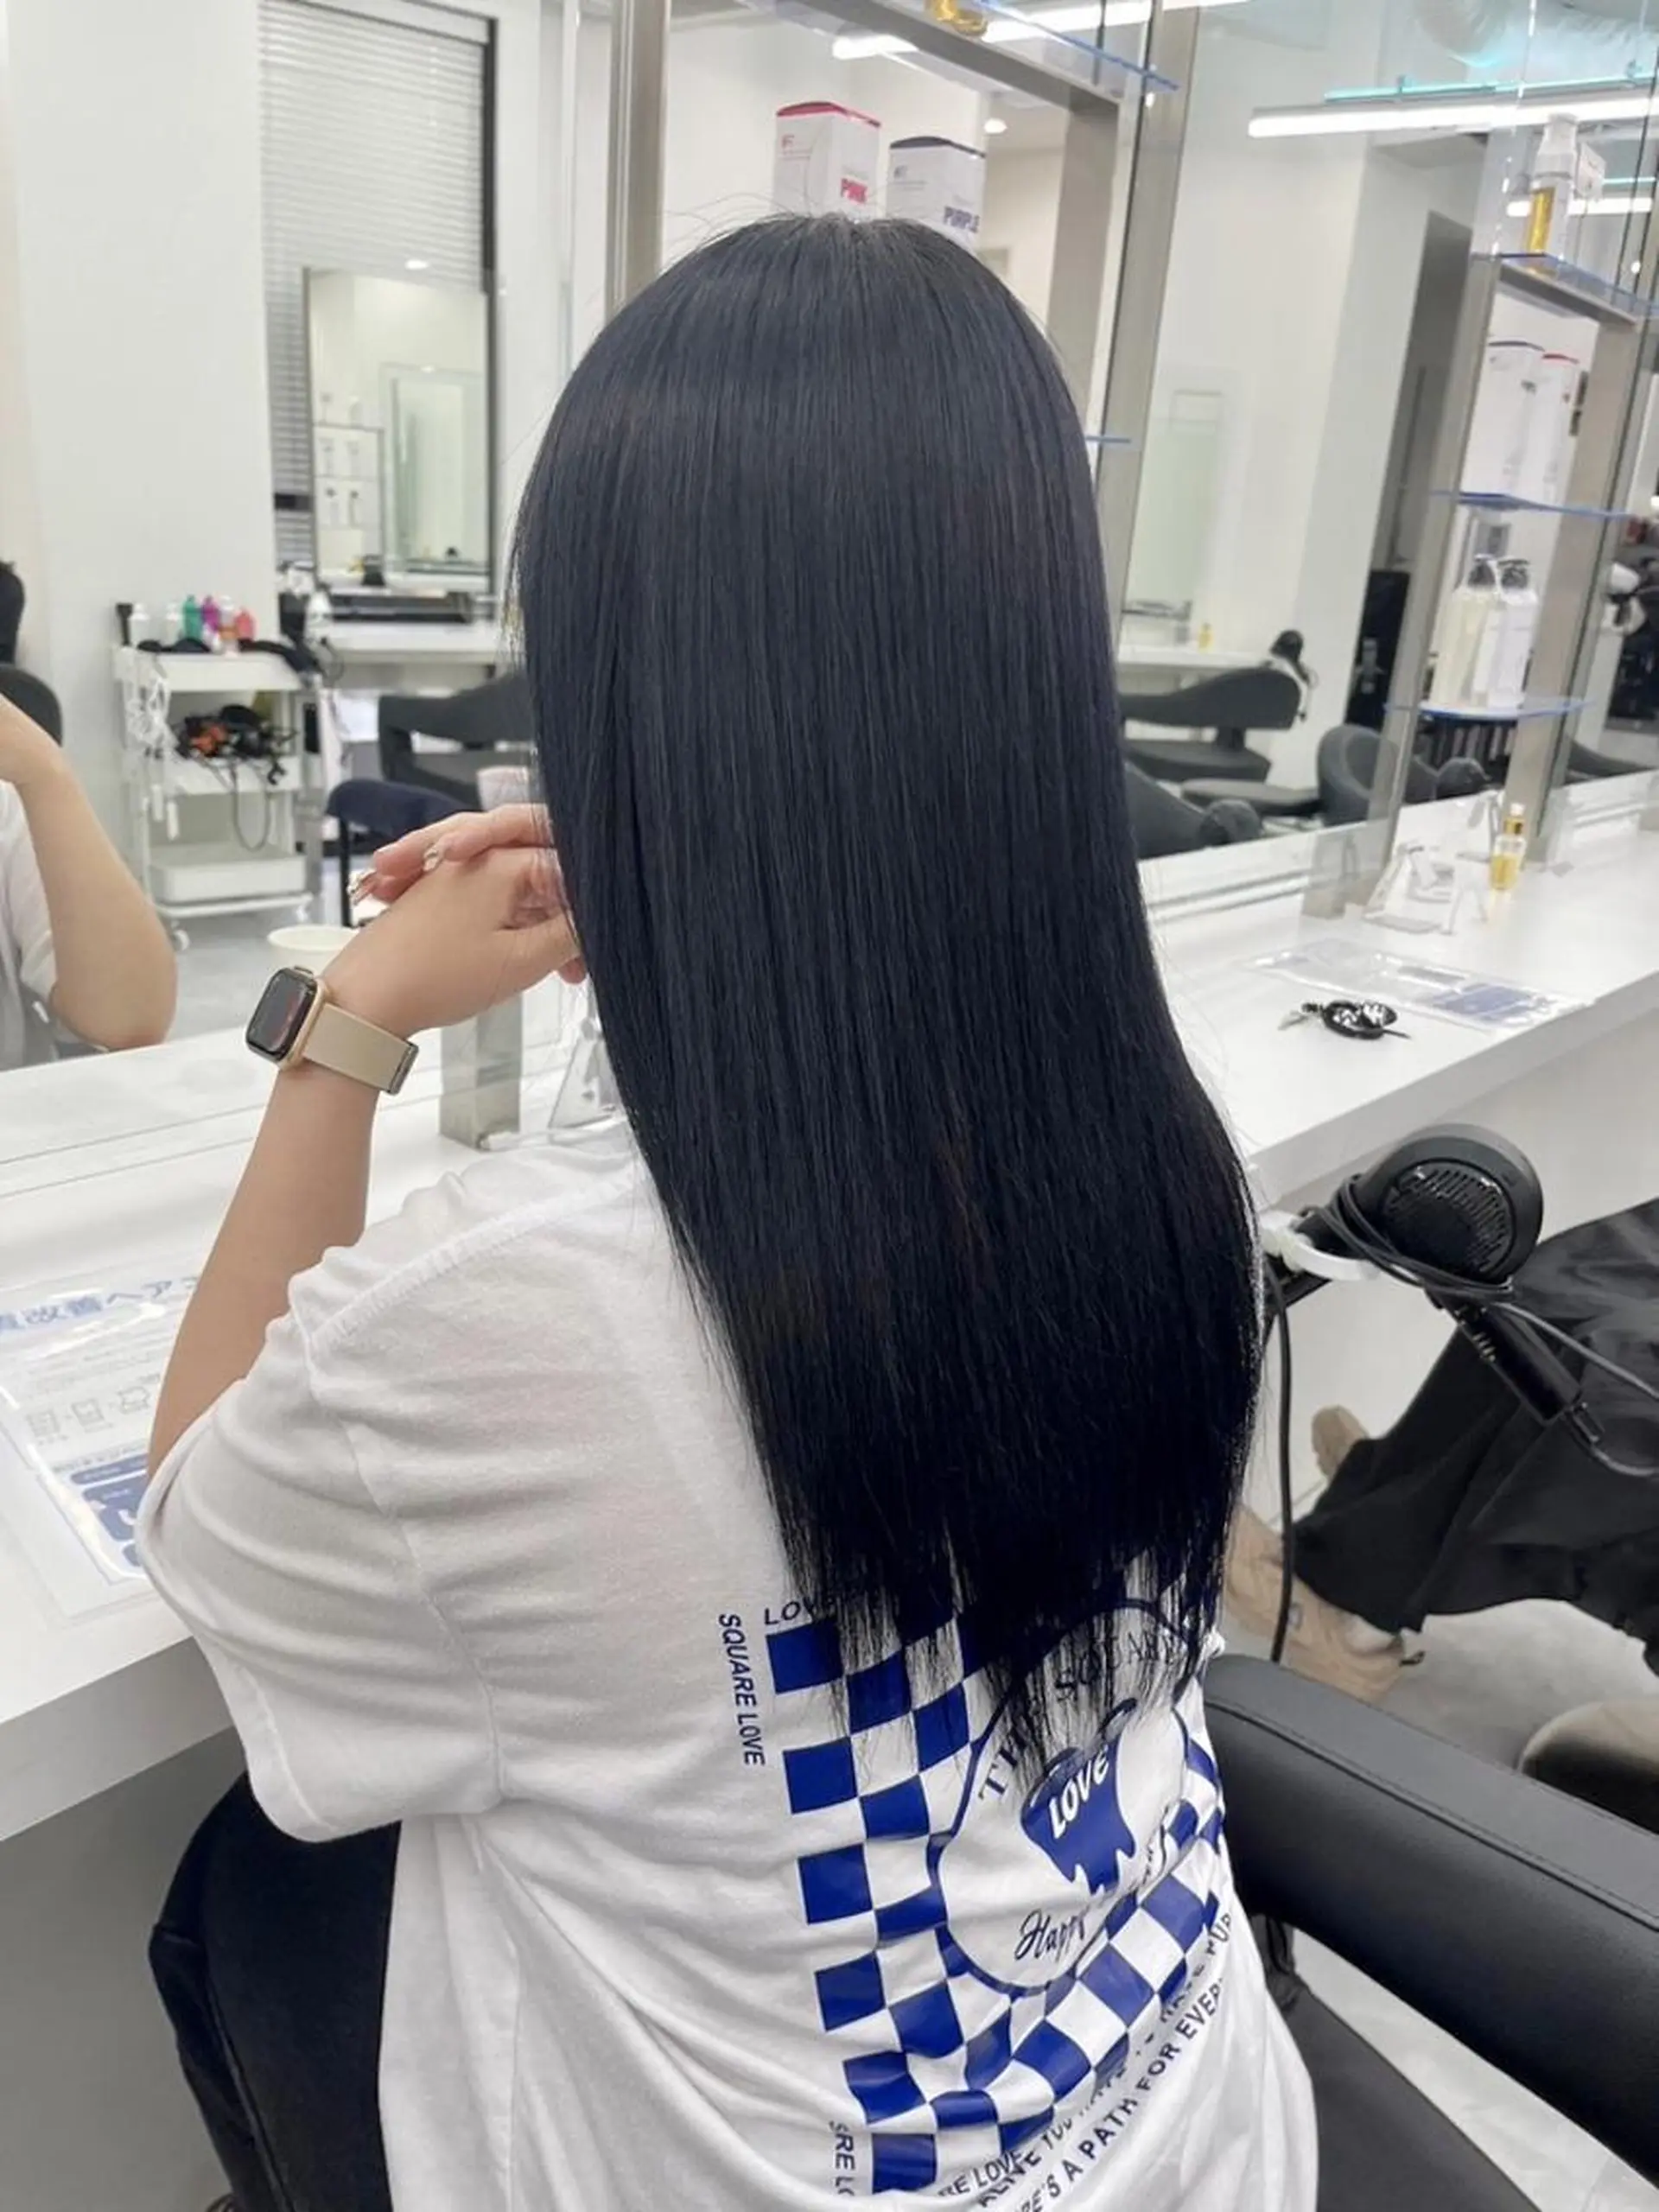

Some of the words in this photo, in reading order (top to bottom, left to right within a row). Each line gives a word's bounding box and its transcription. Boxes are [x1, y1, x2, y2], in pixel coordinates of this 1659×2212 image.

[718, 1613, 757, 1707] SQUARE
[737, 1713, 766, 1766] LOVE
[1048, 1743, 1109, 1839] LOVE
[1062, 2159, 1084, 2182] A
[1078, 2097, 1139, 2160] PATH
[1136, 2042, 1181, 2092] FOR
